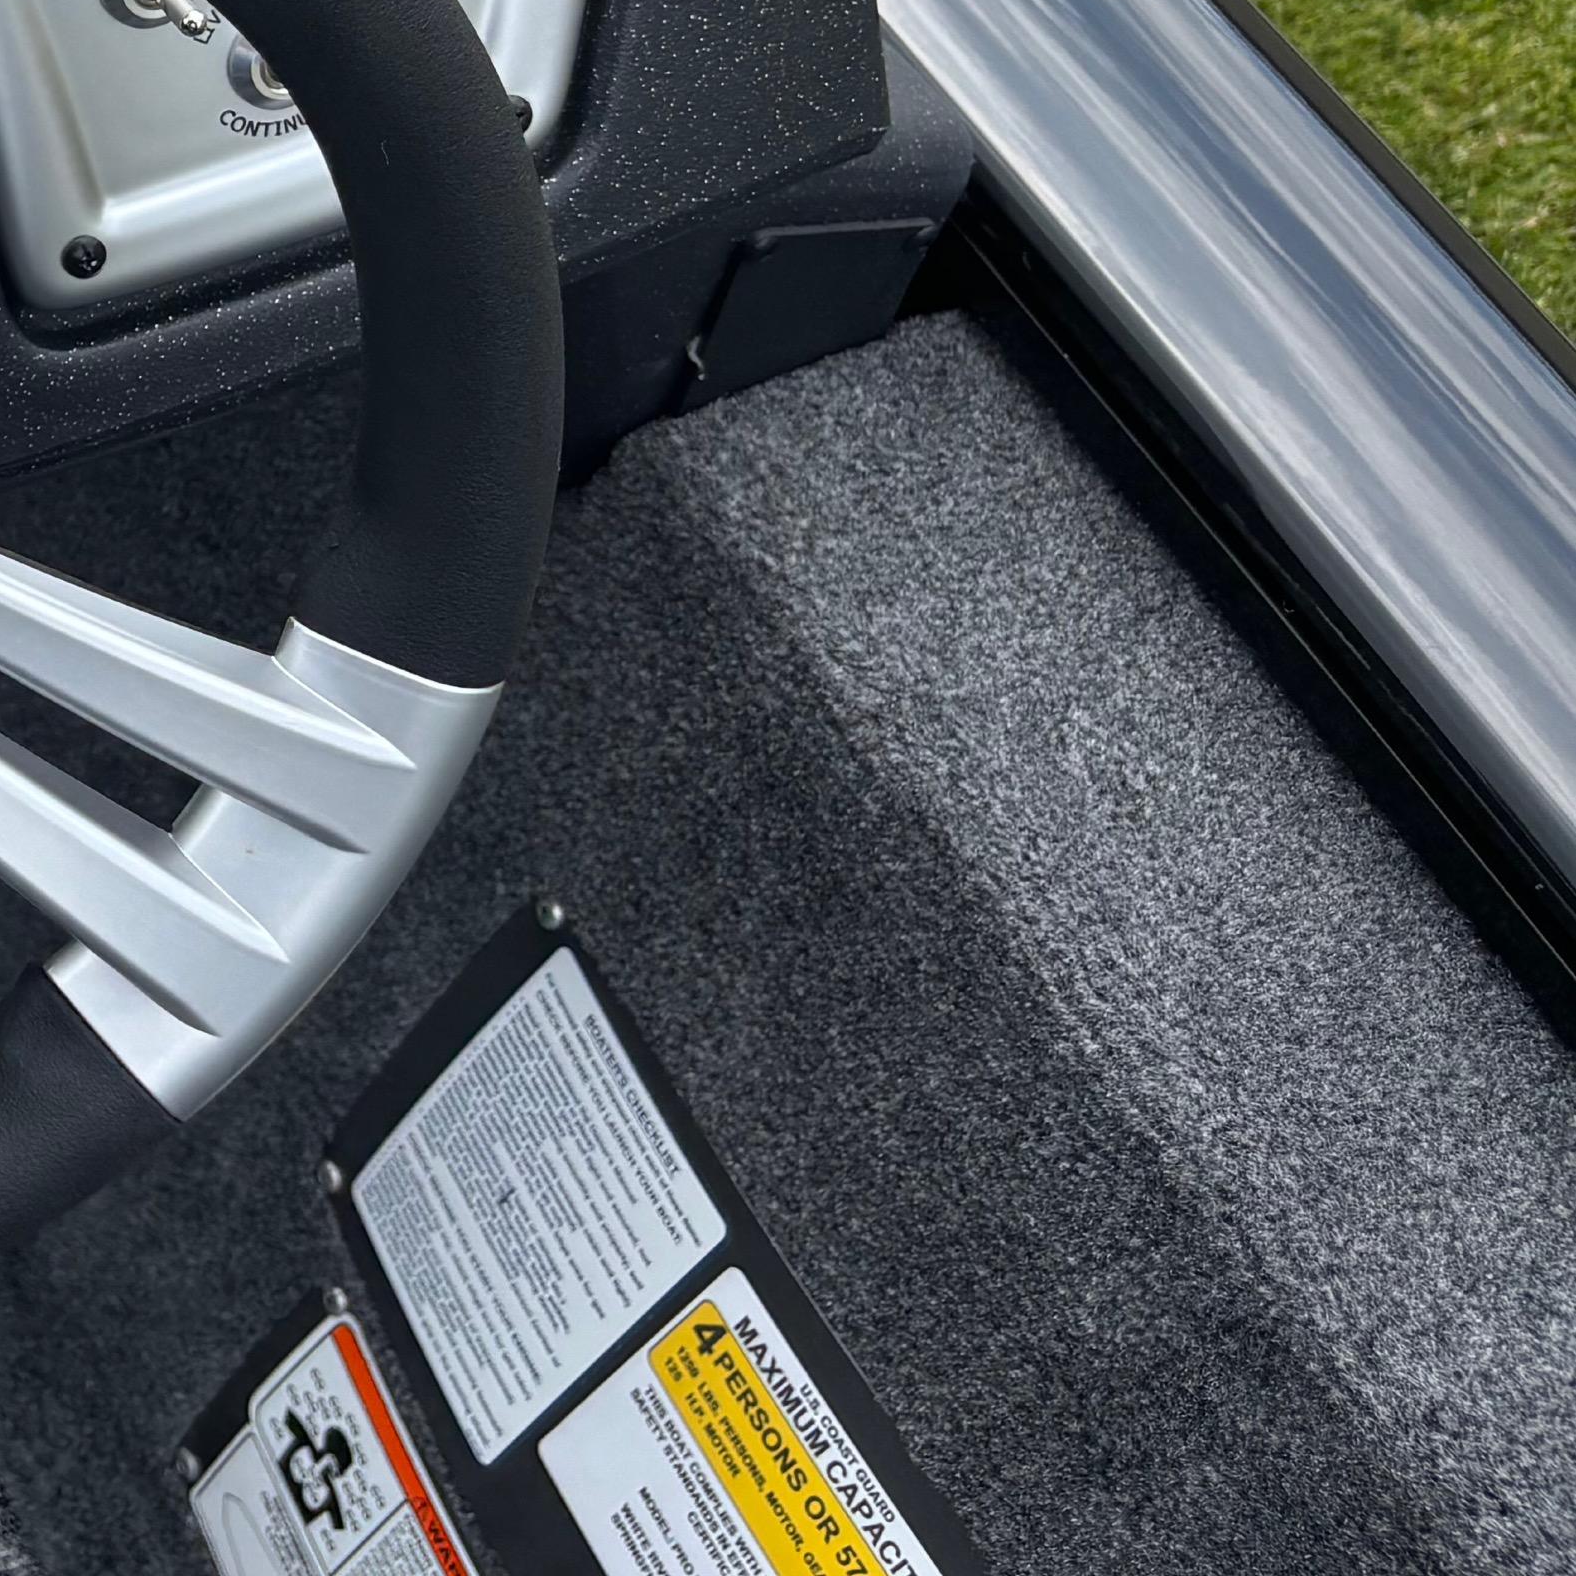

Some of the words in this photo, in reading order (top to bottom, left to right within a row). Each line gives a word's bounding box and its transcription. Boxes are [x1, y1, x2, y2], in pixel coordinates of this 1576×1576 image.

[589, 1086, 606, 1113] YOU
[603, 1113, 636, 1166] LAUNCH
[636, 1168, 659, 1205] YOUR
[626, 1089, 680, 1176] CHECKLIST
[693, 1324, 727, 1355] 4
[713, 1351, 808, 1492] PERSONS
[804, 1495, 840, 1544] OR
[704, 1422, 741, 1478] MOTOR
[734, 1316, 831, 1457] MAXIMUM
[800, 1384, 820, 1416] U.S.
[820, 1415, 859, 1466] COAST
[856, 1469, 895, 1523] GUARD
[621, 1503, 651, 1550] WHITE
[631, 1388, 667, 1441] SAFETY
[664, 1445, 719, 1533] STANDARDS
[717, 1534, 730, 1550] IN
[645, 1387, 666, 1419] THIS
[664, 1420, 692, 1459] BOAT
[689, 1462, 737, 1536] COMPLIES
[719, 1416, 766, 1492] PERSONS,
[765, 1491, 804, 1552] MOTOR,
[639, 1487, 670, 1536] MODEL:
[672, 1543, 694, 1575] PRO
